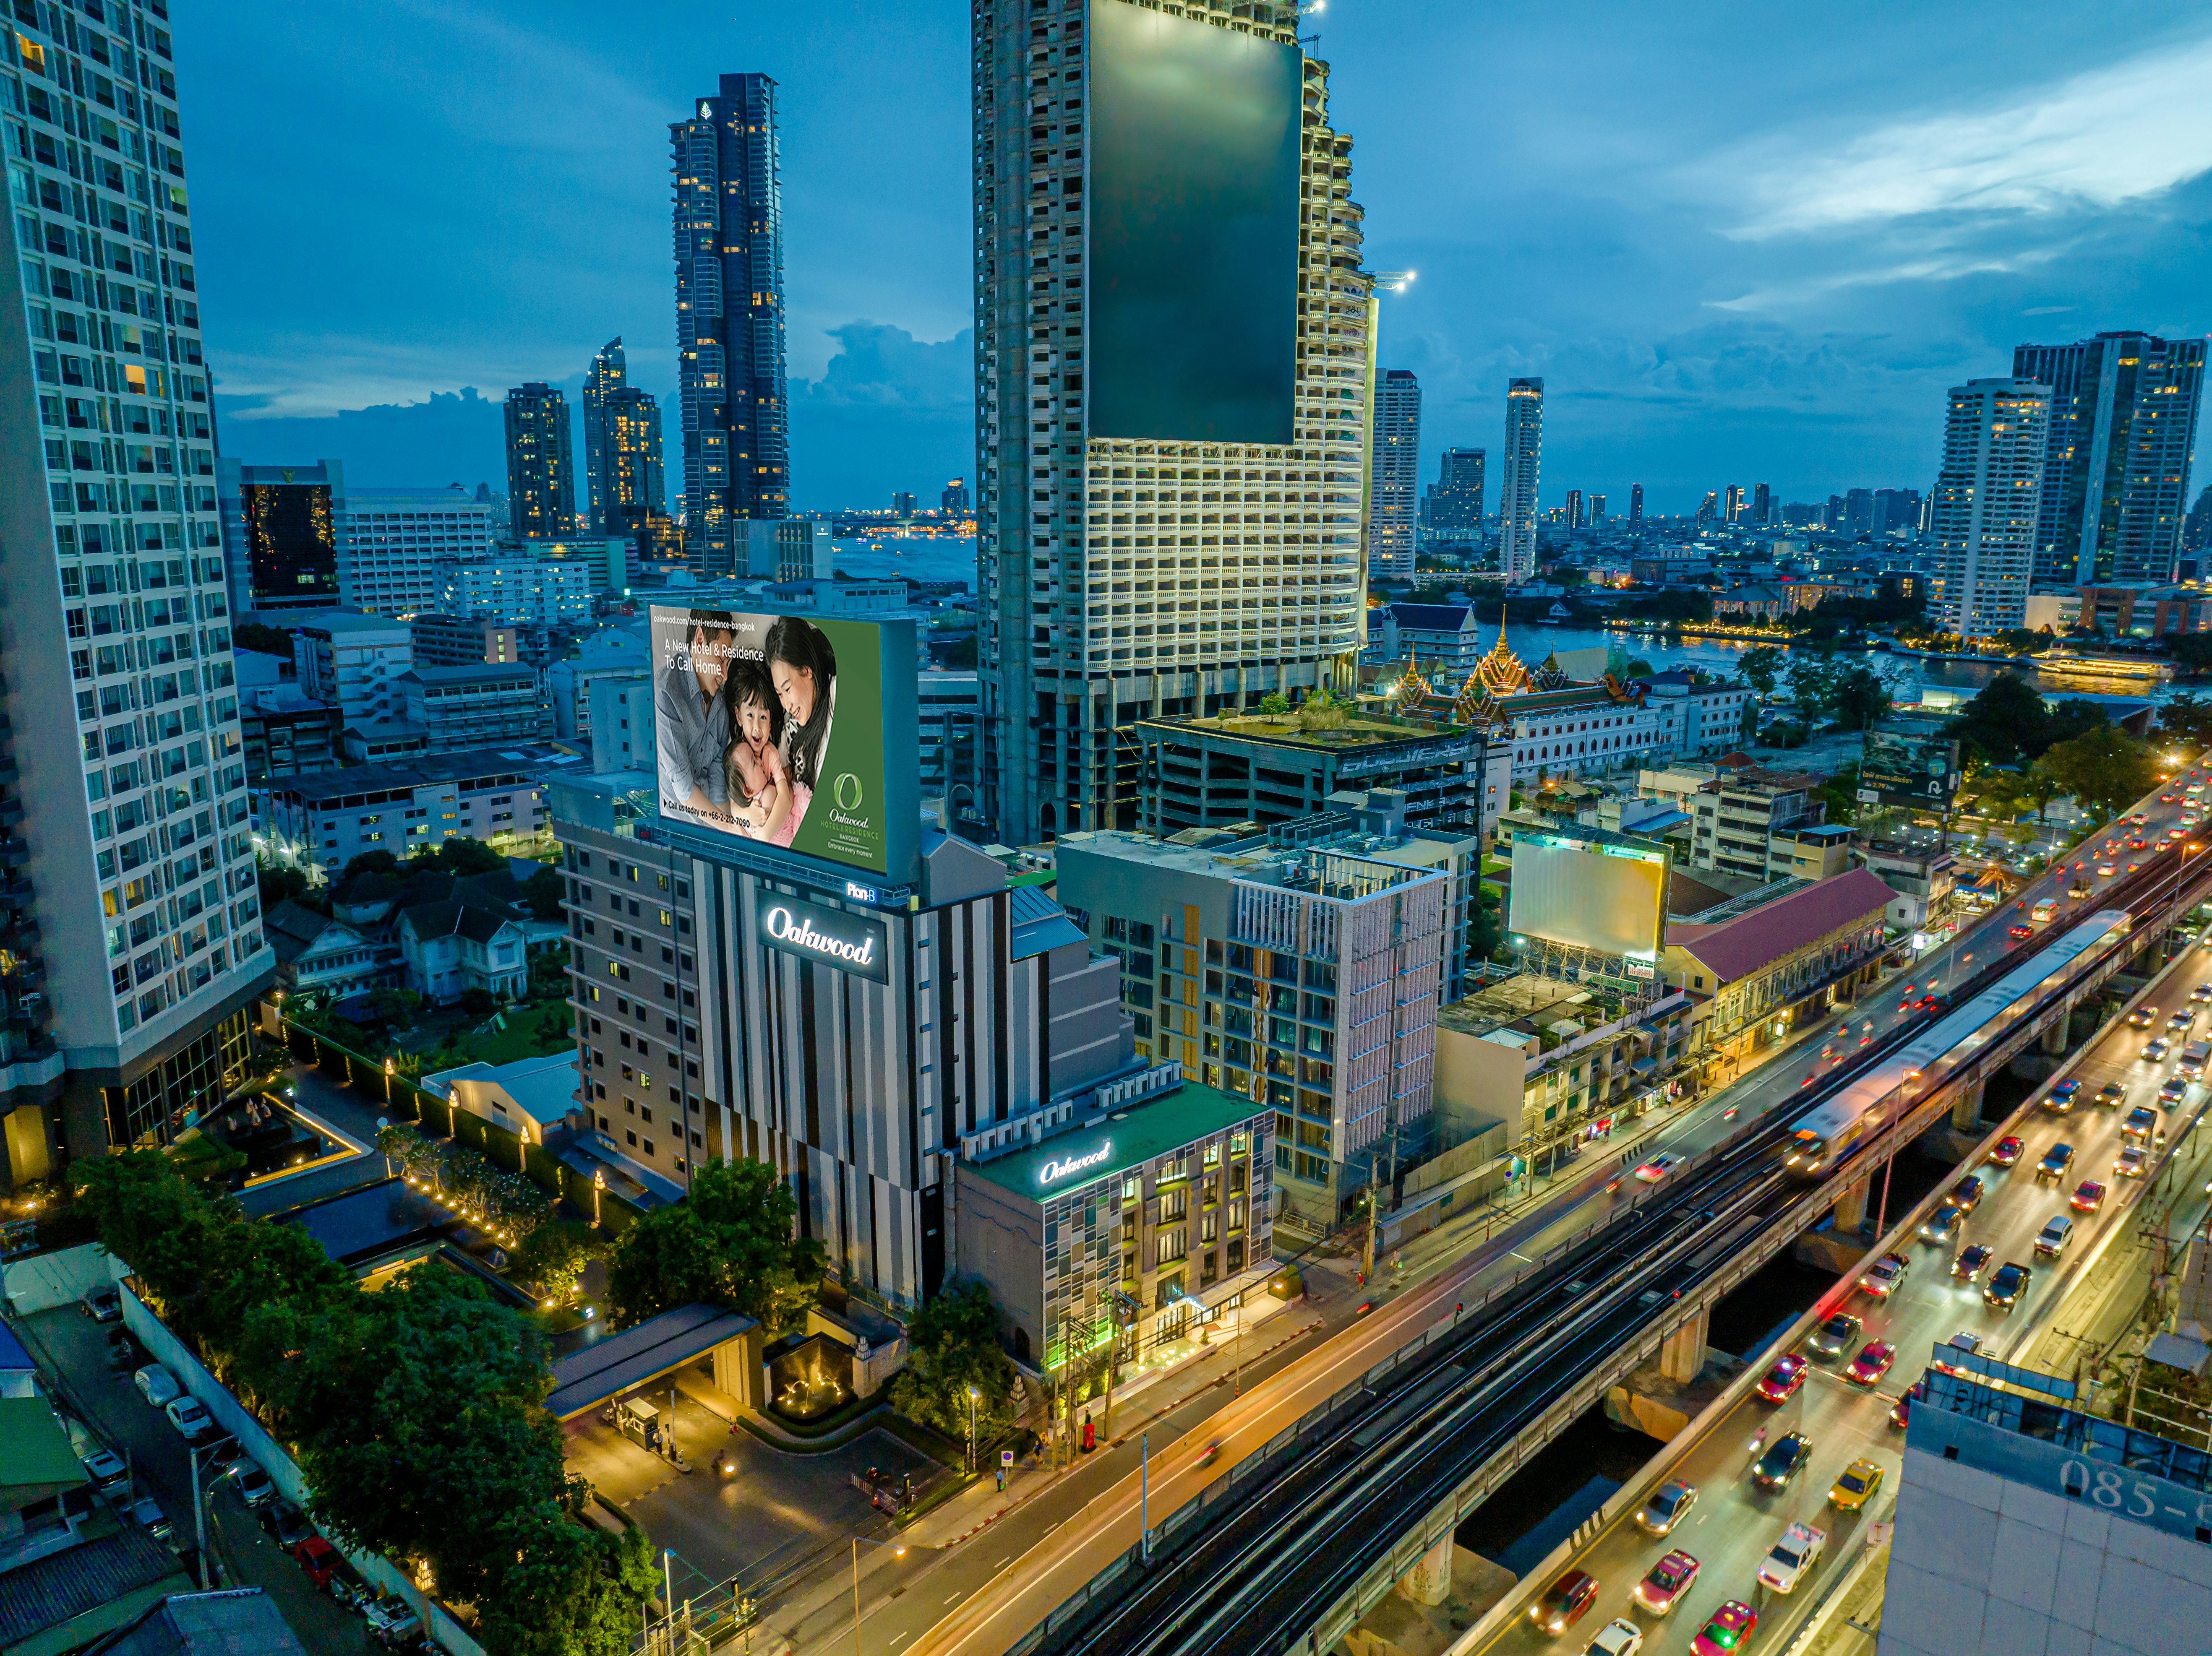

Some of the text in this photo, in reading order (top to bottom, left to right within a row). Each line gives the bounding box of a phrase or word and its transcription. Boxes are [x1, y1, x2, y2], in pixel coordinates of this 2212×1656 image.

[654, 614, 755, 633] oakwood.com/hotel-residence-bangkok
[665, 638, 764, 661] A New Hotel & Residence
[665, 654, 722, 675] To Call Home
[668, 801, 678, 810] Call
[686, 805, 699, 817] today
[709, 811, 750, 828] +66-2-212-7090
[830, 808, 868, 828] Oakwood
[820, 820, 839, 831] HOTEL
[845, 826, 879, 840] RESIDENCE
[828, 841, 844, 851] Embrace
[845, 846, 856, 855] every
[767, 907, 873, 965] Oakwood
[1040, 1142, 1111, 1184] Oakwood
